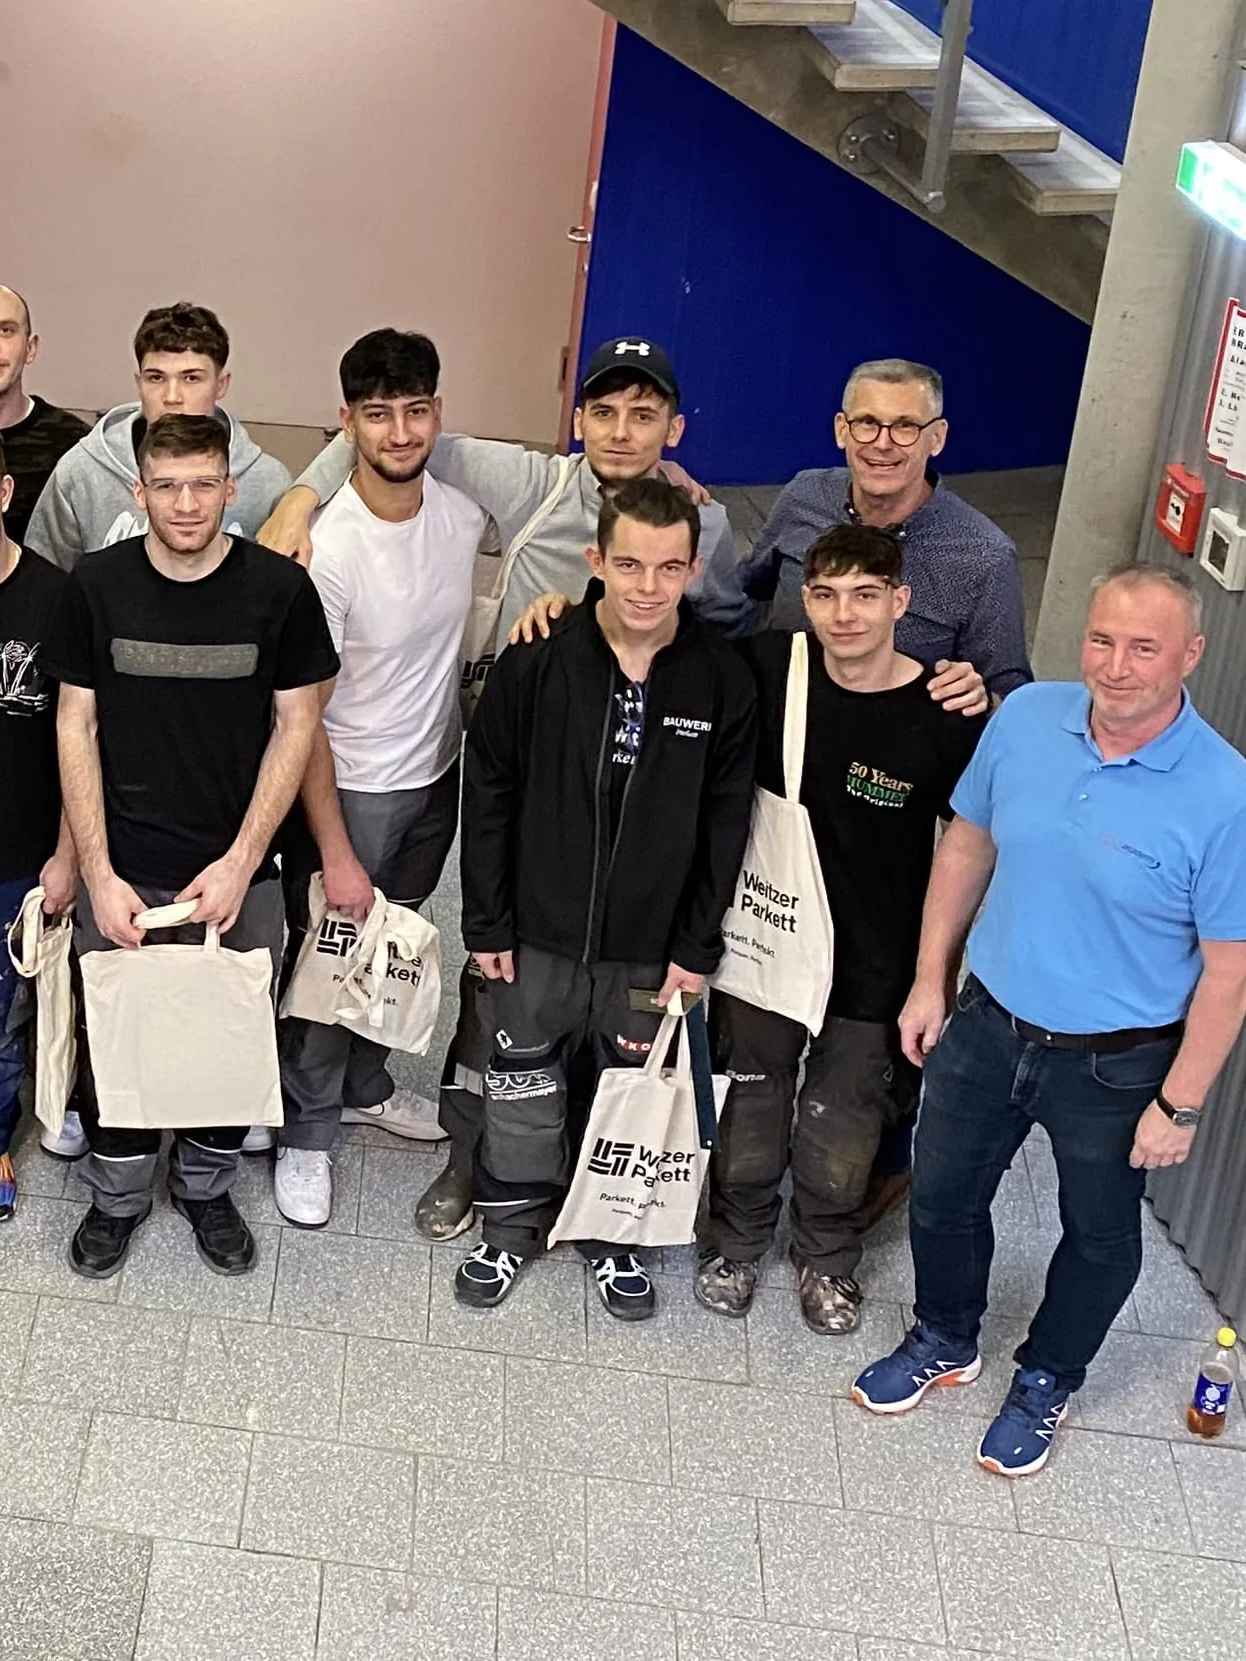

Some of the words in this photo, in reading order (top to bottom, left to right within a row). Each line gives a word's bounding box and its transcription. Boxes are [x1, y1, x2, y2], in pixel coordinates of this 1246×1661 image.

[849, 761, 868, 778] 50
[870, 767, 914, 792] Years
[743, 870, 800, 910] Weitzer
[741, 893, 797, 934] Parkett
